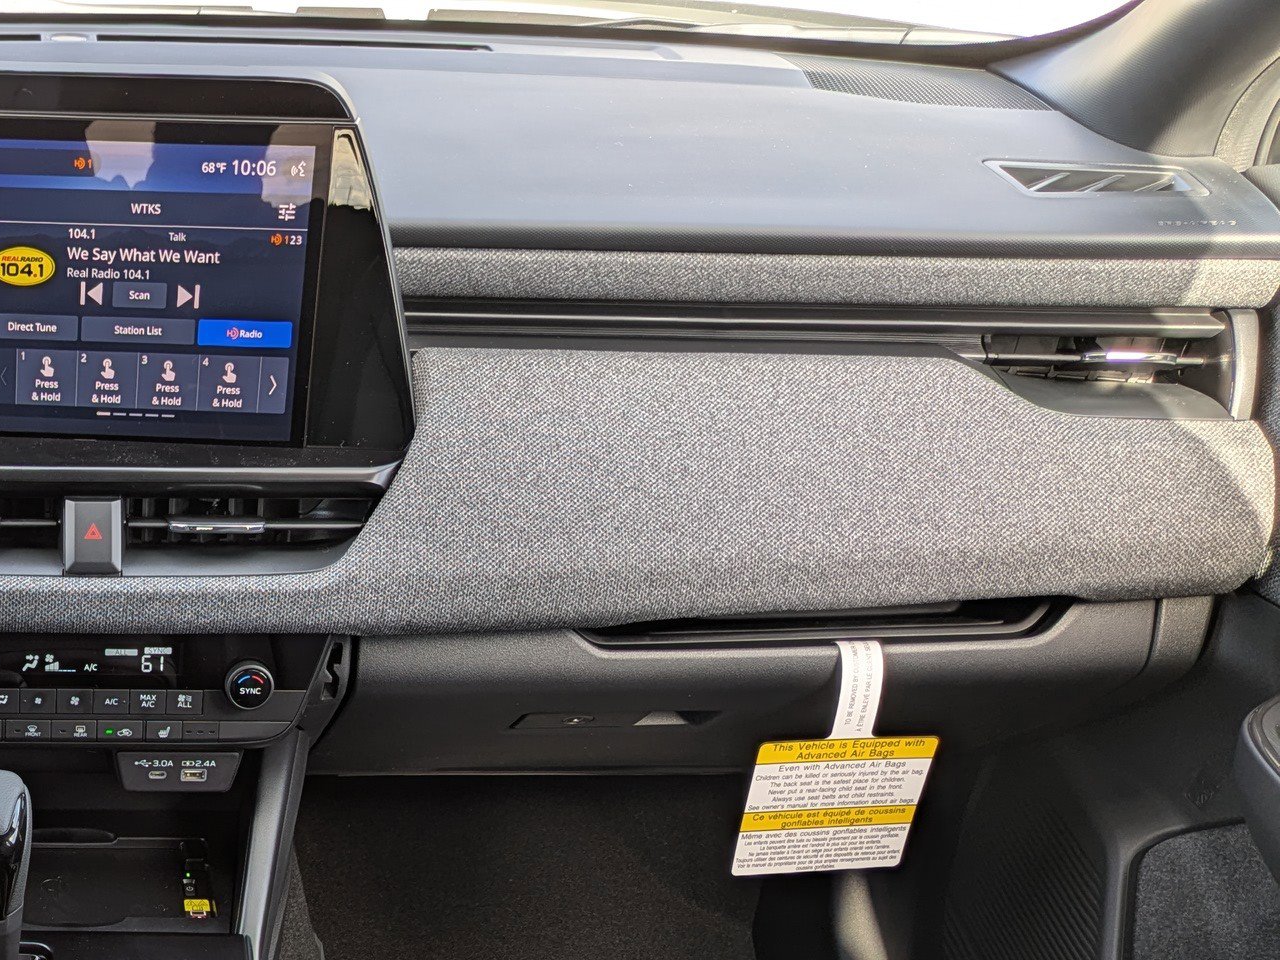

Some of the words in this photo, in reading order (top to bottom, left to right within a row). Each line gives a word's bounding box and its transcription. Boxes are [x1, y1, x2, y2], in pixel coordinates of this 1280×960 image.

[232, 160, 276, 176] 10:06
[131, 204, 161, 215] WTKS
[68, 228, 96, 239] 104.1
[168, 232, 186, 242] Talk
[67, 247, 89, 260] We
[92, 248, 116, 264] Say
[119, 248, 155, 262] What
[159, 250, 180, 263] We
[184, 250, 220, 264] Want
[0, 262, 44, 278] 104.1
[67, 268, 89, 278] Real
[91, 268, 120, 279] Radio
[123, 269, 150, 279] 104.1
[129, 291, 150, 300] Scan
[8, 322, 34, 332] Direct
[35, 323, 57, 333] Tune
[114, 325, 145, 335] Station
[147, 327, 162, 336] List
[239, 329, 263, 339] Radio
[21, 352, 25, 360] 1
[81, 354, 87, 363] 2
[142, 356, 148, 364] 3
[202, 358, 209, 366] 4
[35, 379, 58, 389] Press
[95, 381, 119, 391] Press
[155, 383, 179, 393] Press
[217, 385, 240, 395] Press
[32, 393, 38, 401] &
[41, 392, 61, 402] Hold
[92, 395, 99, 403] &
[100, 394, 121, 404] Hold
[152, 397, 159, 405] &
[161, 396, 181, 406] Hold
[212, 399, 220, 407] &
[221, 398, 242, 408] Hold
[83, 663, 98, 672] A/C
[141, 655, 164, 673] 61
[239, 687, 262, 695] SYNC
[104, 698, 119, 706] A/C
[773, 744, 793, 752] This
[799, 742, 835, 751] Vehicle
[852, 740, 900, 750] Equipped
[905, 739, 925, 747] with
[796, 751, 847, 760] Advanced
[850, 750, 864, 758] Air
[869, 749, 895, 759] Bags
[152, 759, 174, 767] 3.0A
[195, 759, 216, 767] 2.4A
[779, 764, 800, 772] Even
[824, 761, 866, 770] Advanced
[885, 760, 907, 769] Bags
[768, 811, 803, 820] véhicule
[823, 809, 852, 818] équipé
[854, 808, 866, 816] de
[868, 807, 906, 815] coussins
[780, 819, 824, 830] gonflables
[828, 817, 873, 826] intelligents
